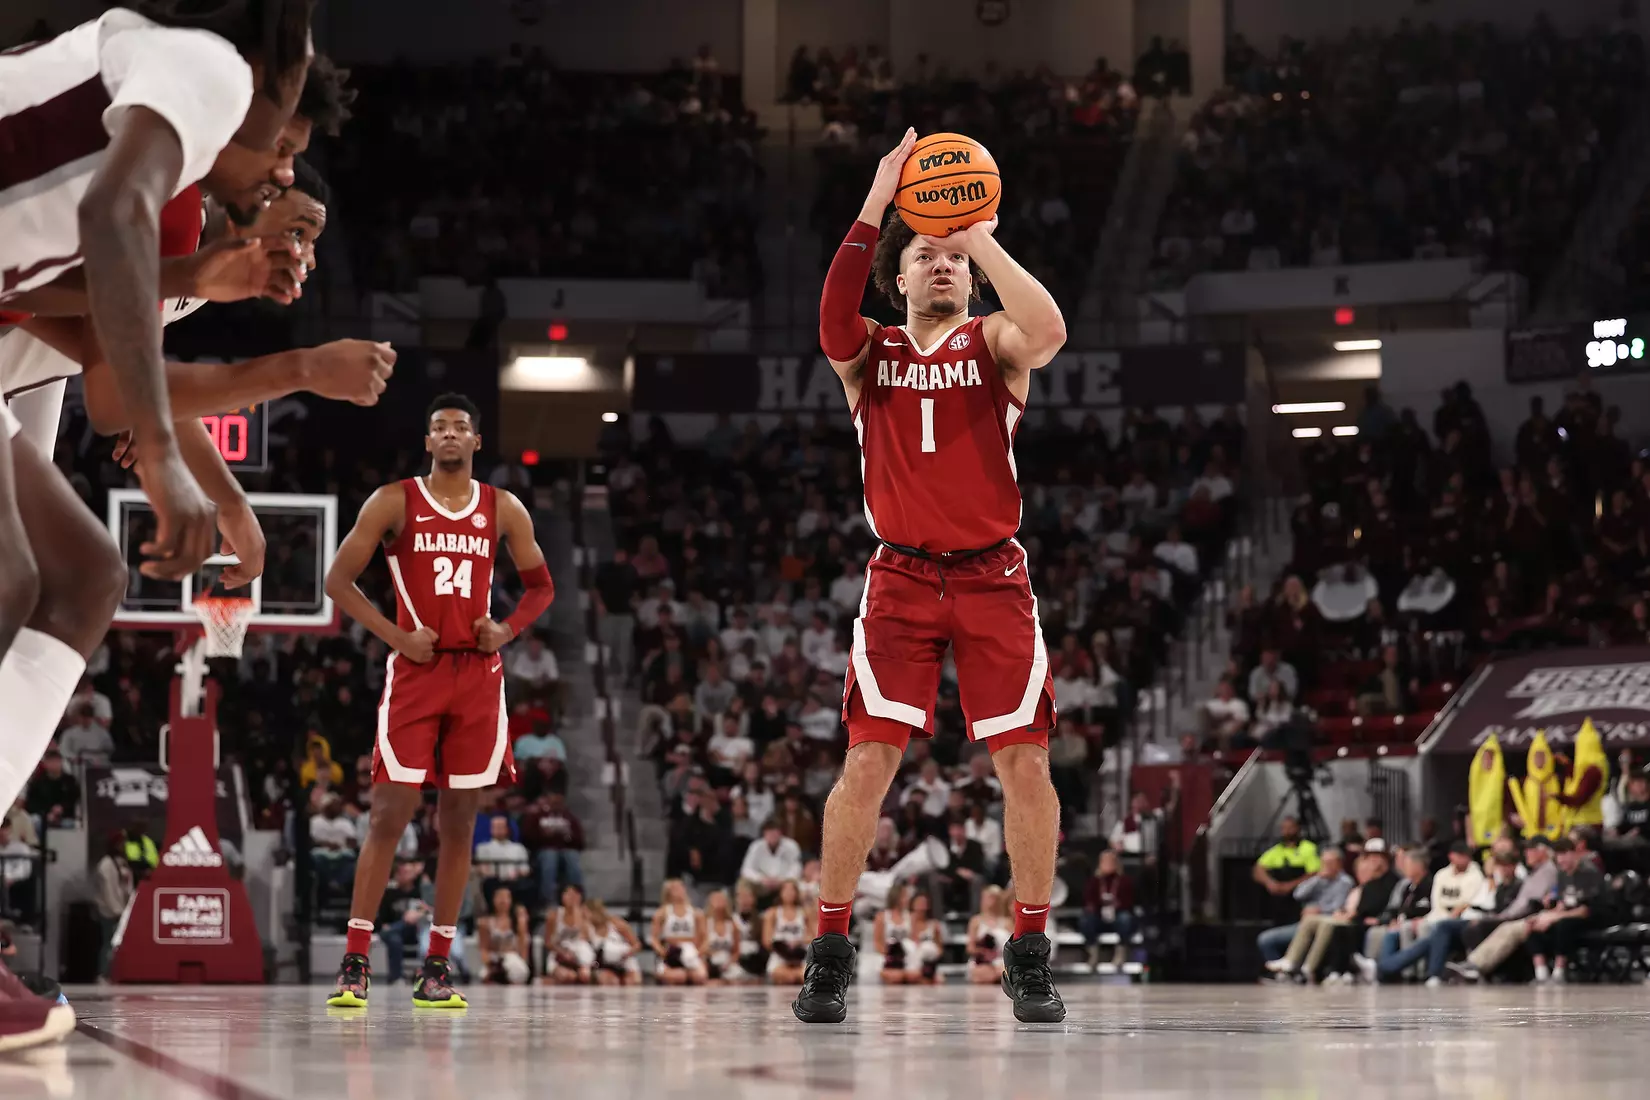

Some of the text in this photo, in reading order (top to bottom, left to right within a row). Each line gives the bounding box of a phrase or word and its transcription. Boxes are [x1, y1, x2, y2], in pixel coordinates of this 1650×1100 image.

[919, 151, 970, 171] NCAA
[915, 180, 987, 205] Wilson
[950, 334, 969, 349] SEC
[877, 359, 982, 391] ALABAMA
[921, 398, 936, 452] 1
[413, 532, 490, 558] ALABAMA
[433, 556, 473, 599] 24
